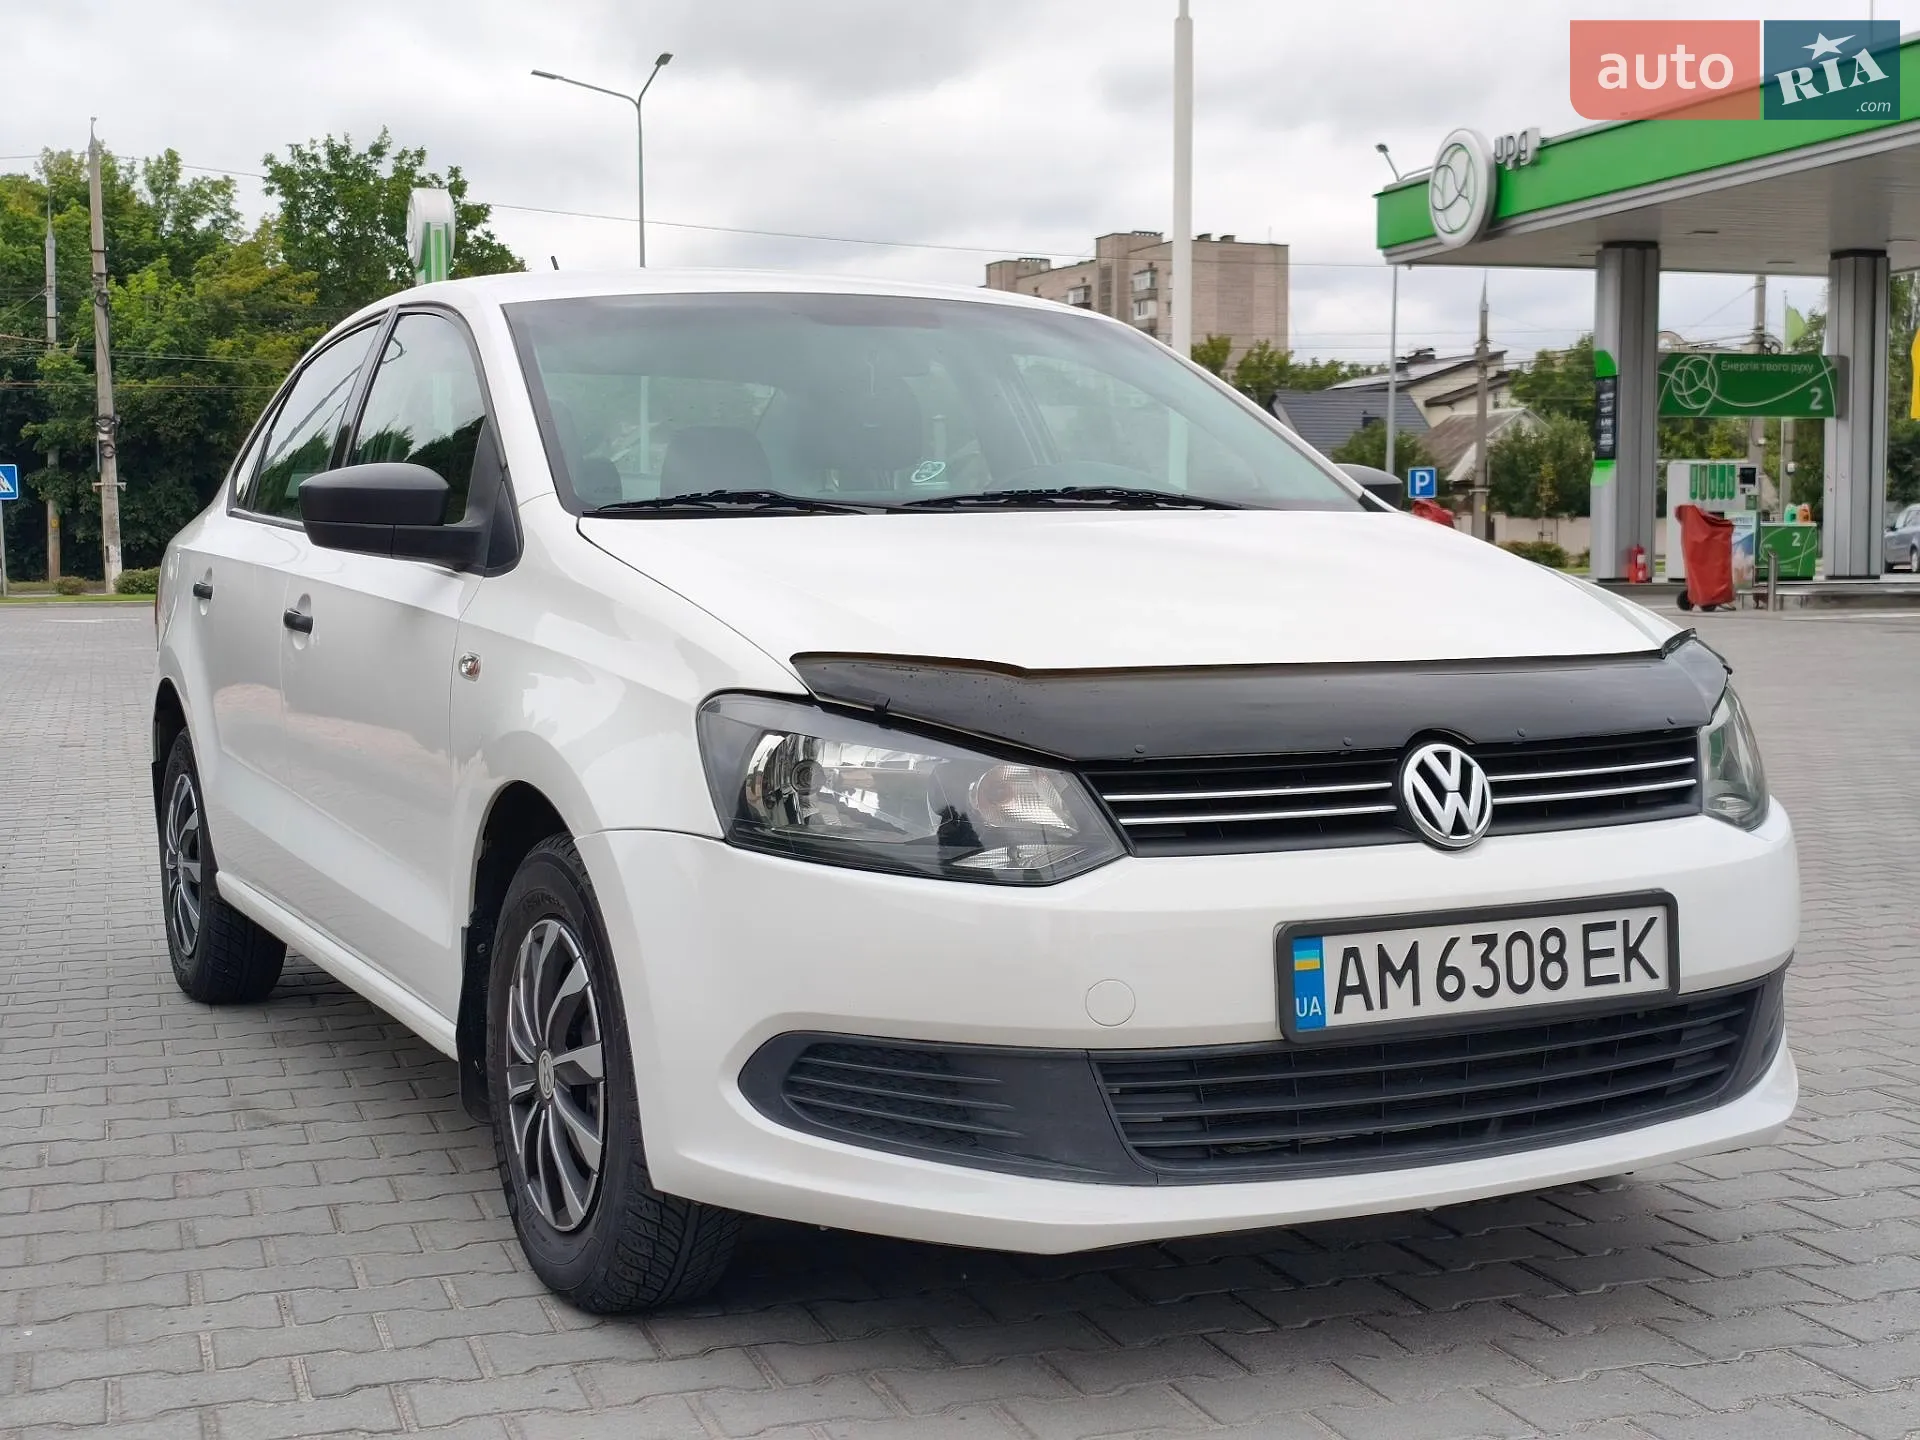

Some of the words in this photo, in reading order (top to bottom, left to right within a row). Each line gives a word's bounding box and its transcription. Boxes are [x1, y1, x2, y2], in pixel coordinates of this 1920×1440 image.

[1494, 128, 1540, 170] upg
[1809, 387, 1823, 410] 2
[1415, 471, 1430, 494] P
[1791, 532, 1801, 546] 2
[1333, 940, 1421, 1015] AM
[1436, 927, 1569, 1002] 6308
[1582, 916, 1660, 987] EK
[1295, 996, 1322, 1018] UA
